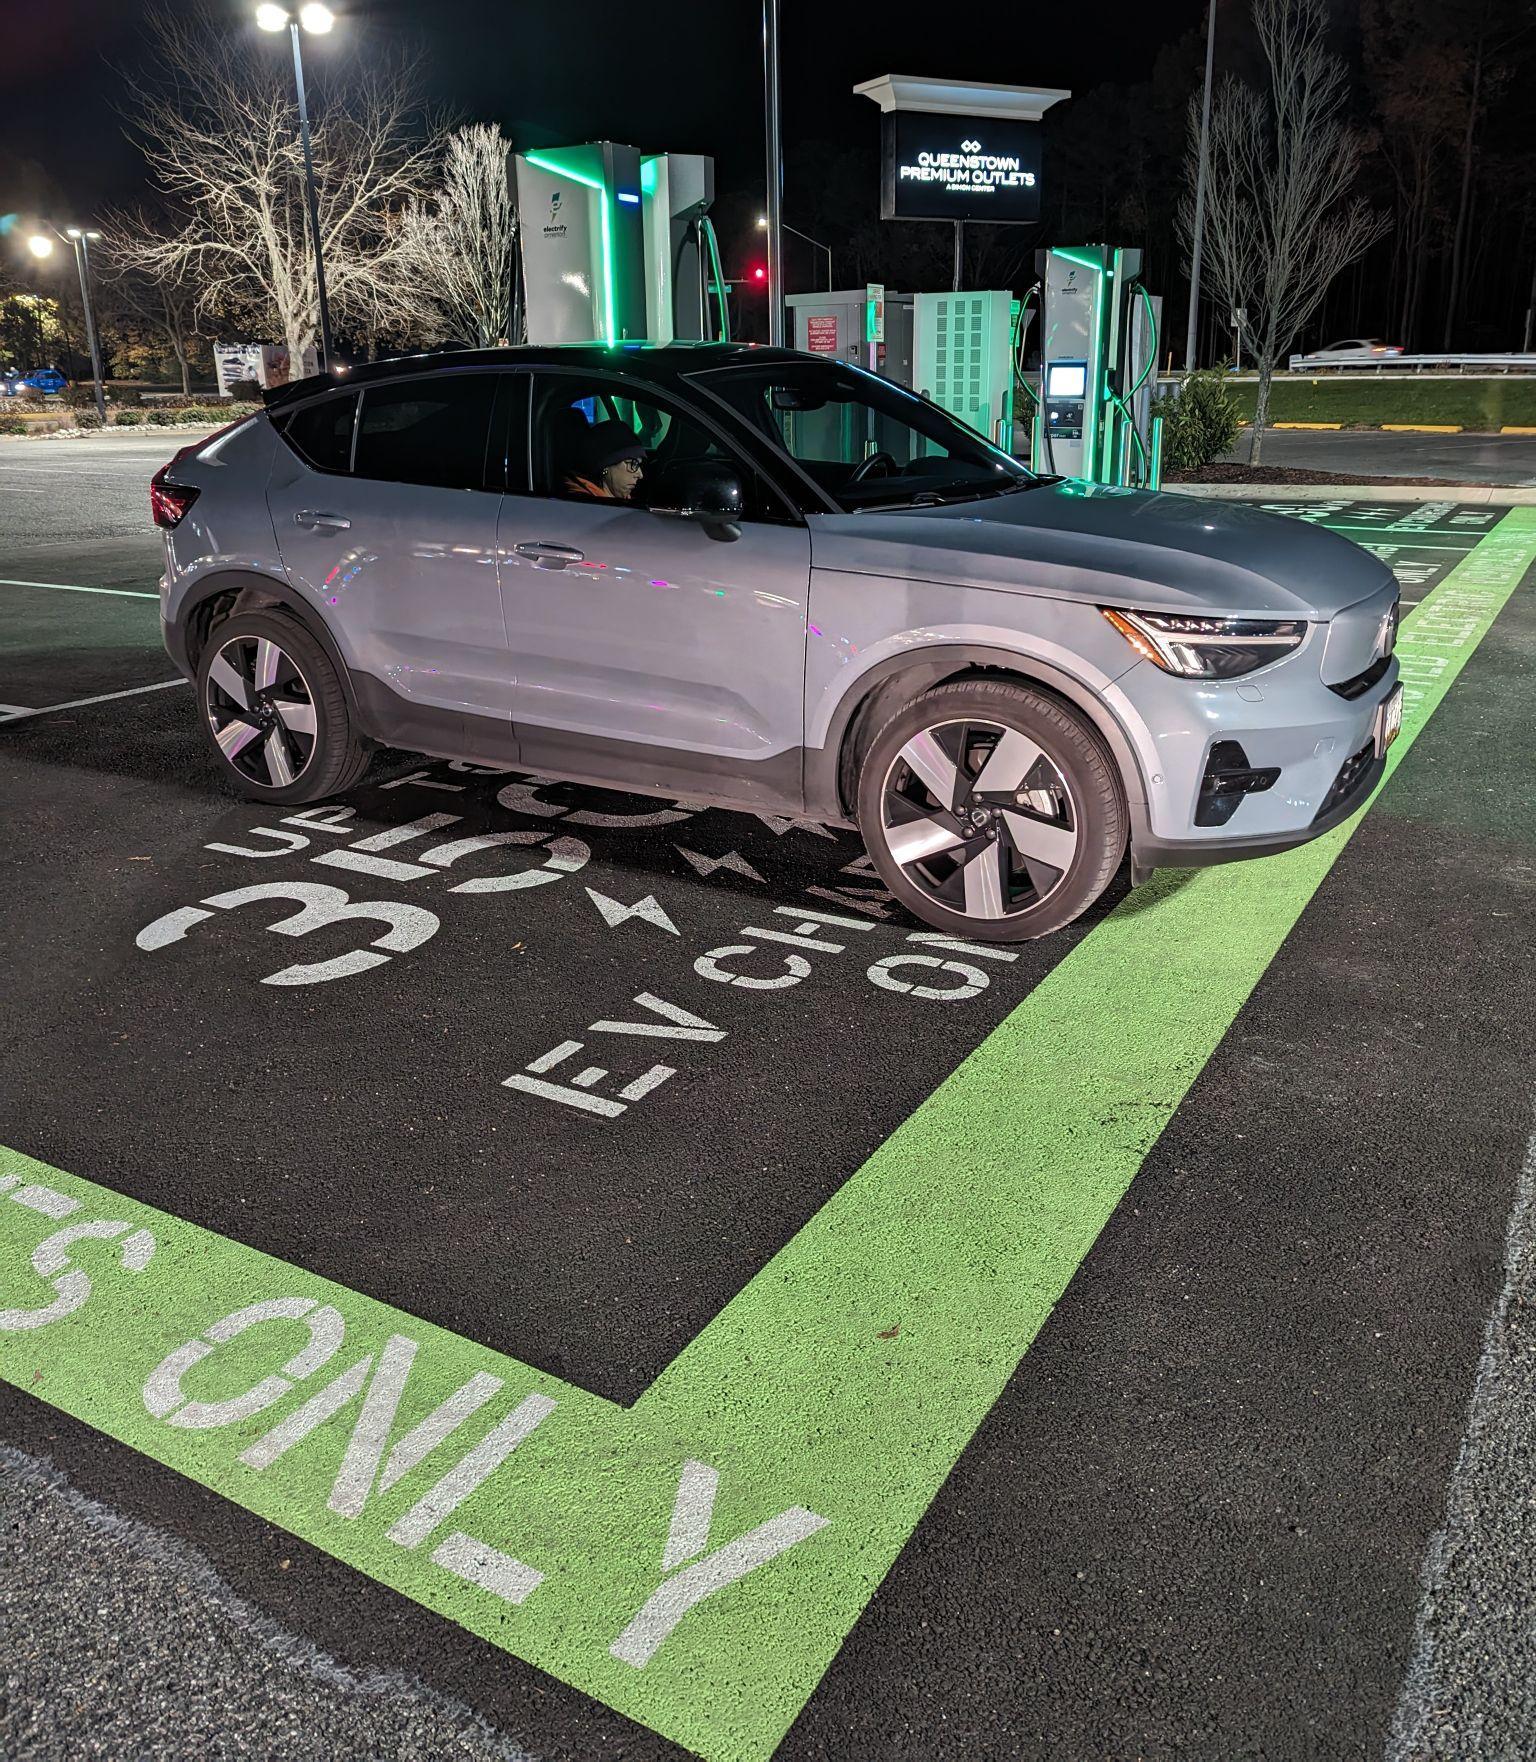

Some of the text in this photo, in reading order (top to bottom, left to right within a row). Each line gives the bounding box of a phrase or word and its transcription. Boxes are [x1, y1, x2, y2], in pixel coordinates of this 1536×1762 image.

[900, 166, 1035, 186] PREMIUM OUTLETS
[918, 152, 1019, 171] QUEENSTOWN
[208, 804, 354, 859] UP
[501, 992, 728, 1118] EV
[142, 1296, 829, 1668] ONLY
